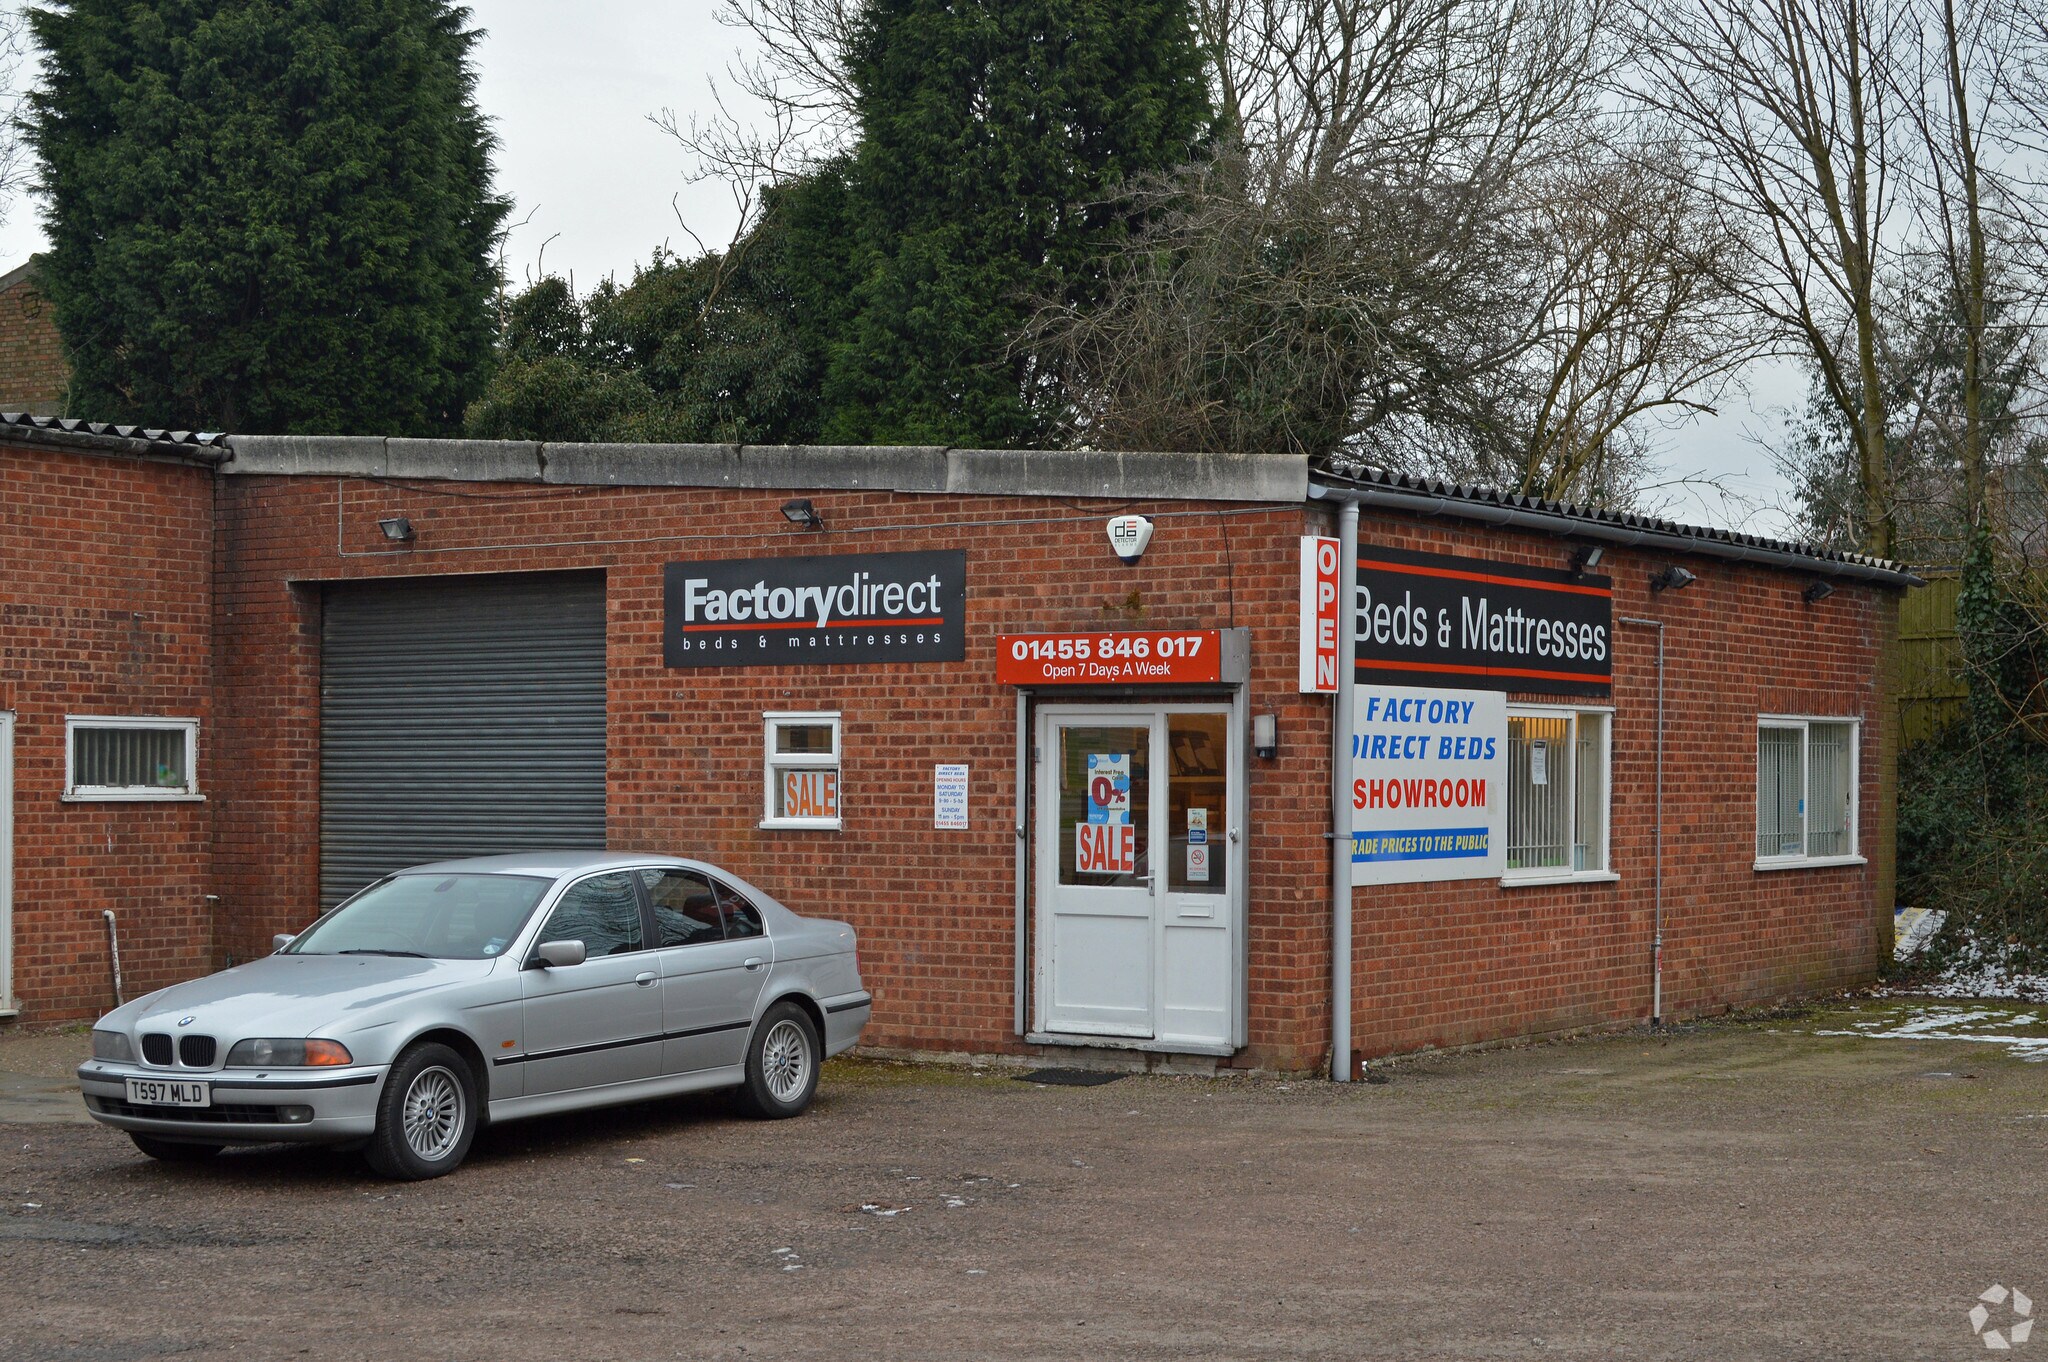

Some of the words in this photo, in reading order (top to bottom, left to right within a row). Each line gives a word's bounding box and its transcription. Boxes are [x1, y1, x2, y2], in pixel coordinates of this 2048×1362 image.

[684, 572, 941, 628] Factorydirect
[1318, 544, 1337, 686] OPEN
[1355, 585, 1428, 647] Beds
[1437, 608, 1452, 648] &
[1462, 596, 1606, 661] Mattresses
[684, 638, 738, 650] beds
[759, 634, 767, 648] &
[789, 632, 941, 647] mattresses
[1011, 639, 1091, 660] 01455
[1098, 638, 1150, 659] 846
[1156, 637, 1202, 657] 017
[1043, 663, 1075, 679] Open
[1078, 663, 1086, 676] 7
[1089, 662, 1120, 678] Days
[1122, 662, 1133, 675] A
[1135, 662, 1171, 675] Week
[1366, 697, 1475, 724] FACTORY
[1438, 736, 1496, 760] BEDS
[786, 773, 836, 816] SALE
[1091, 776, 1126, 807] 0%
[1353, 778, 1486, 809] SHOWROOM
[1080, 824, 1133, 871] SALE
[1352, 838, 1378, 855] RADE
[1381, 836, 1417, 854] PRICES
[1420, 836, 1432, 852] TO
[1435, 835, 1454, 852] THE
[1455, 834, 1488, 851] PUBLIC
[131, 1082, 166, 1101] T597
[170, 1084, 202, 1102] MLD
